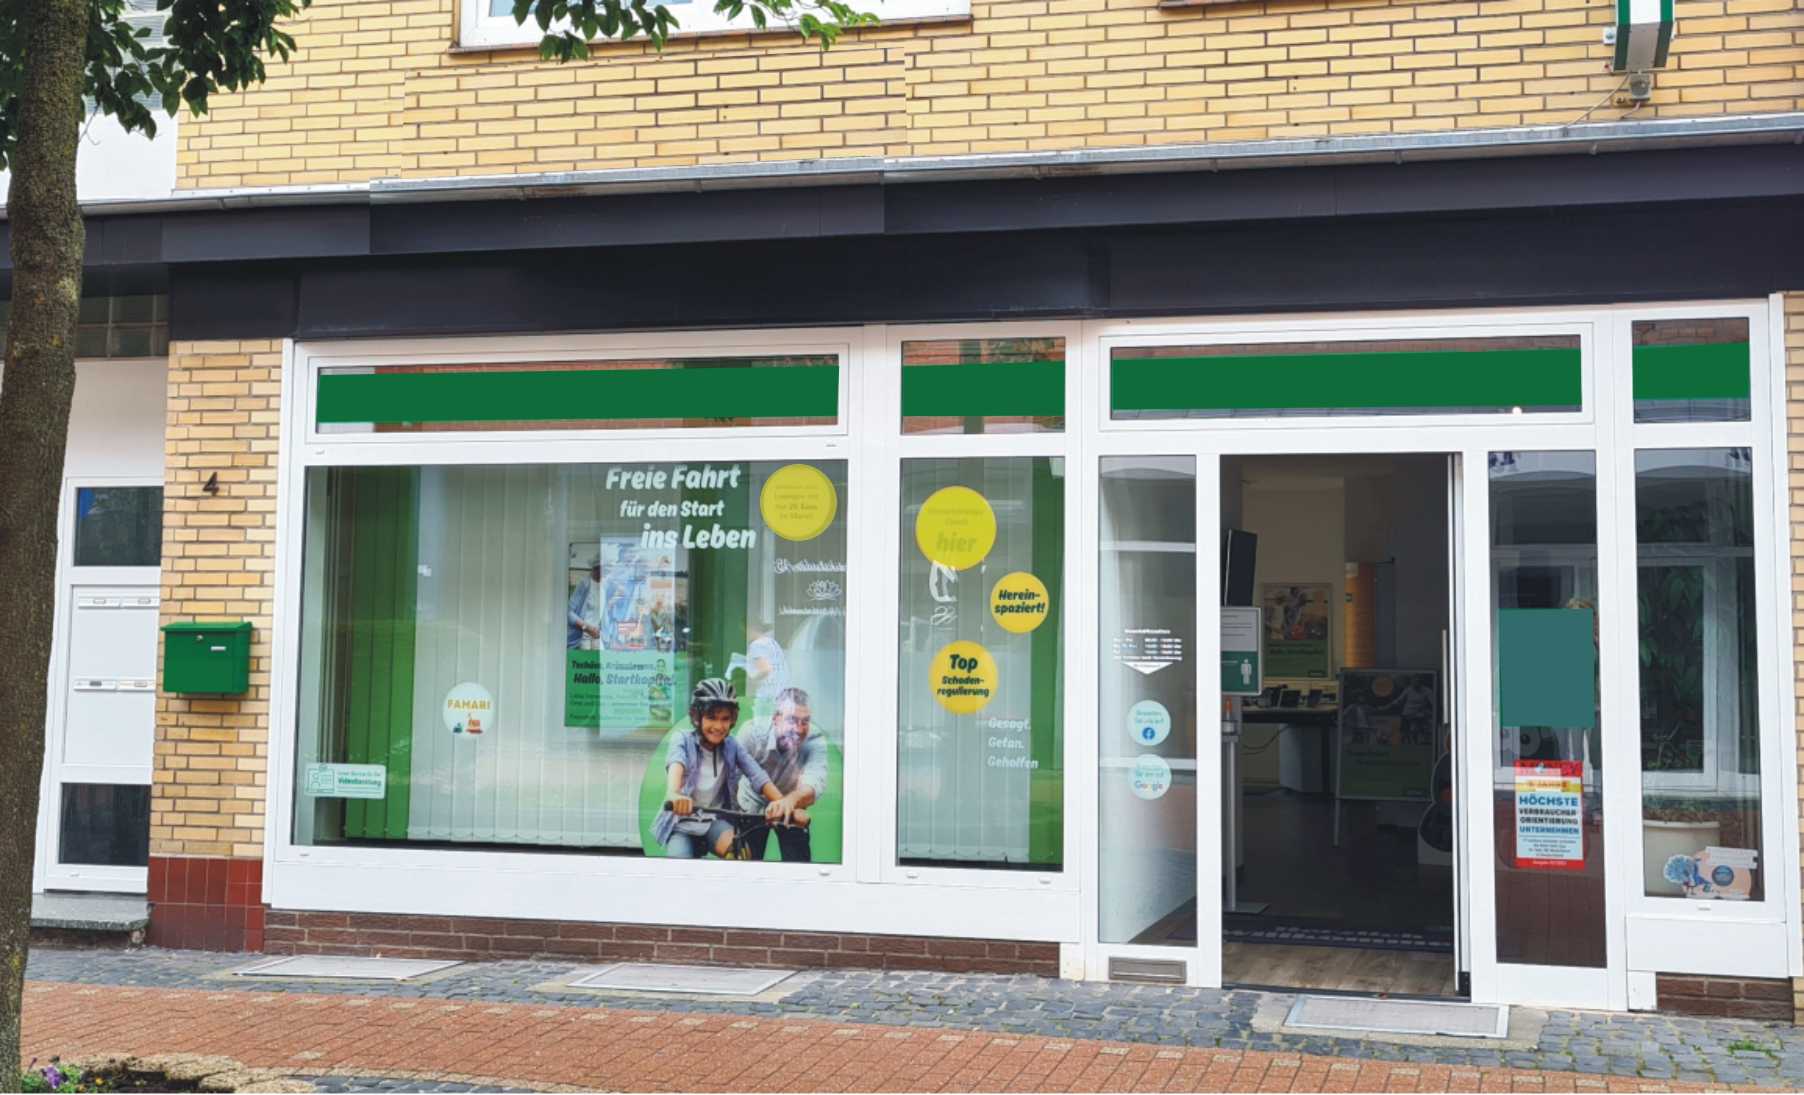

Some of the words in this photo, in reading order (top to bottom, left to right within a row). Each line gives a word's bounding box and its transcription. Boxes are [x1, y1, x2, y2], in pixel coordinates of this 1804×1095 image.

[203, 472, 219, 496] 4
[605, 465, 665, 490] Freie
[671, 464, 741, 489] Fahrt
[619, 500, 644, 517] für
[648, 500, 677, 517] den
[680, 500, 724, 517] Start
[640, 523, 677, 549] ins
[683, 524, 756, 549] Leben
[936, 531, 977, 553] hier
[998, 589, 1040, 601] Herein-
[994, 602, 1045, 616] spaziert!
[950, 654, 978, 673] Top
[936, 687, 989, 698] regulierung
[1519, 793, 1578, 807] HÖCHSTE
[1519, 826, 1579, 834] UNTERNEHMEN
